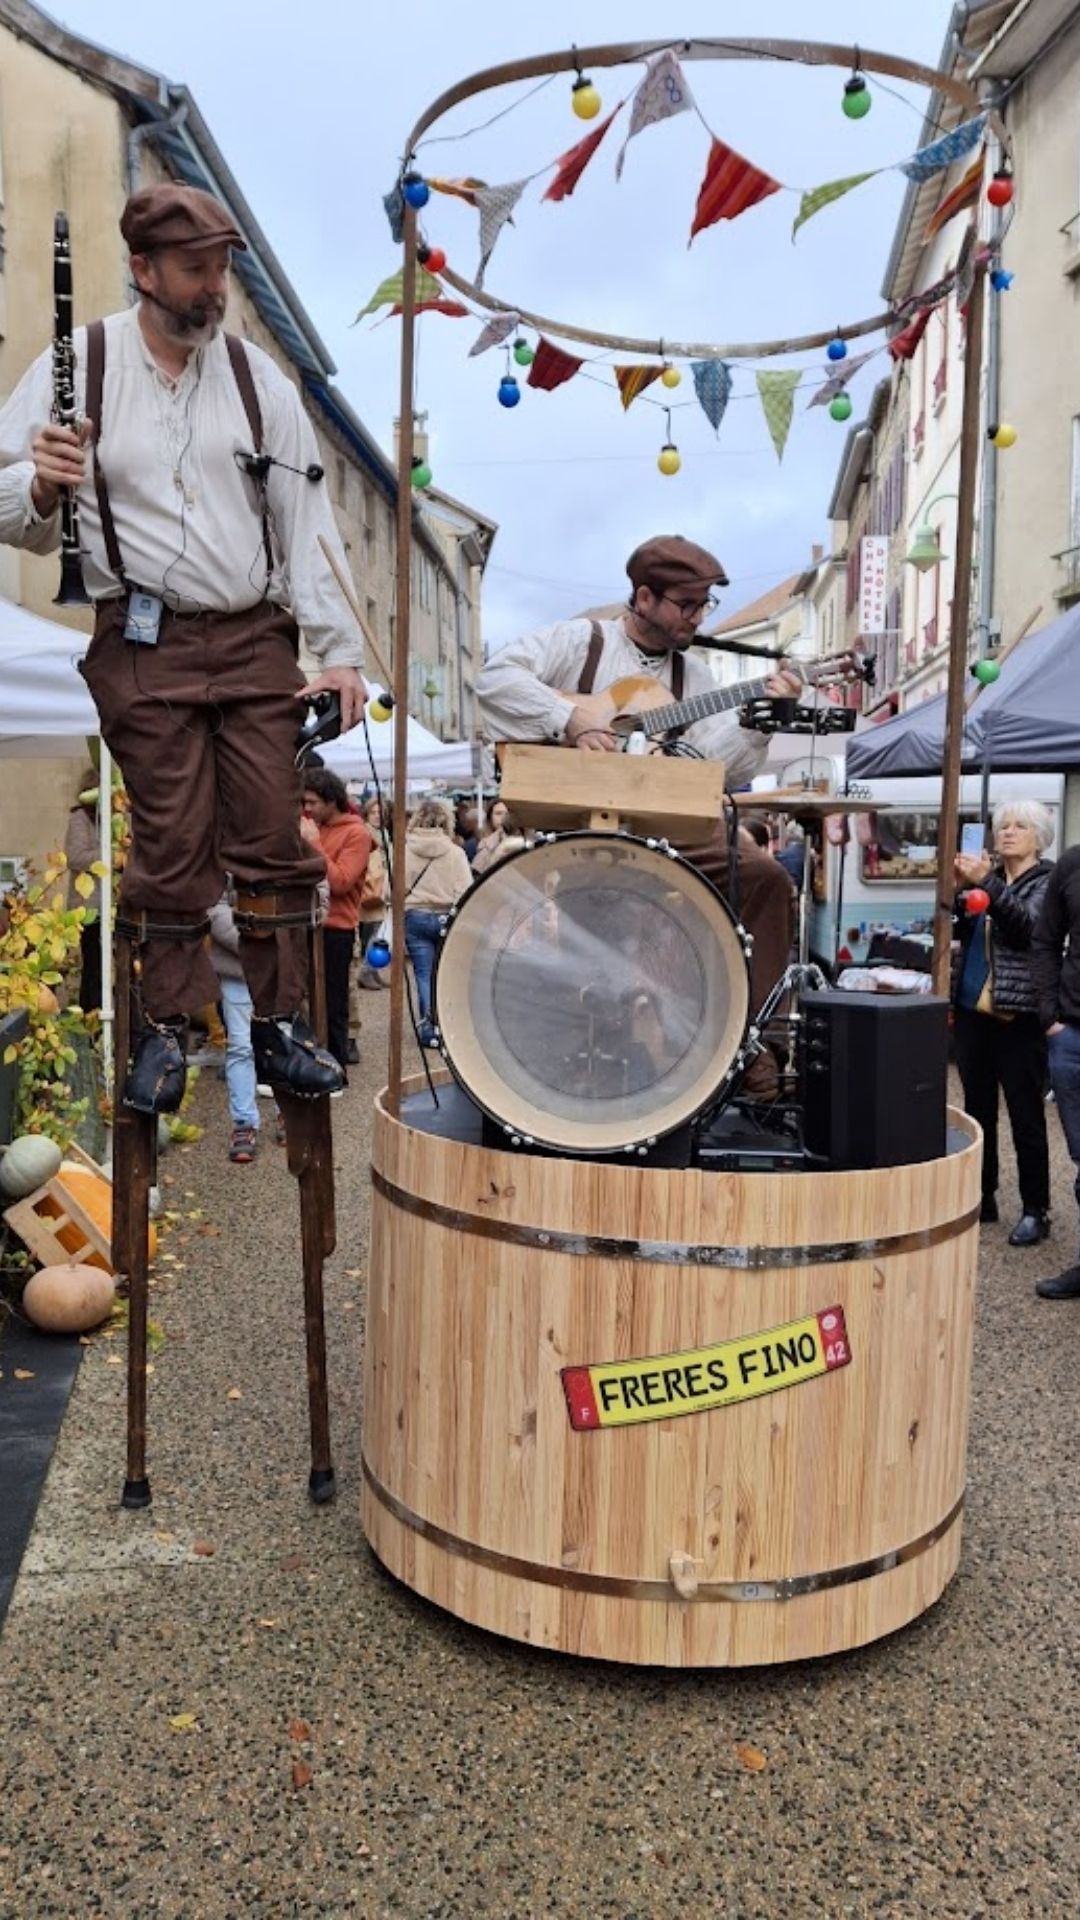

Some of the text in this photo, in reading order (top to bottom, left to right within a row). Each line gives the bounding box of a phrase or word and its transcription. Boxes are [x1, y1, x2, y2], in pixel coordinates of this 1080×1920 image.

[863, 540, 874, 631] CHAMBRES
[599, 1333, 816, 1411] FRERES FINO
[827, 1341, 846, 1361] 42
[581, 1408, 590, 1420] F
